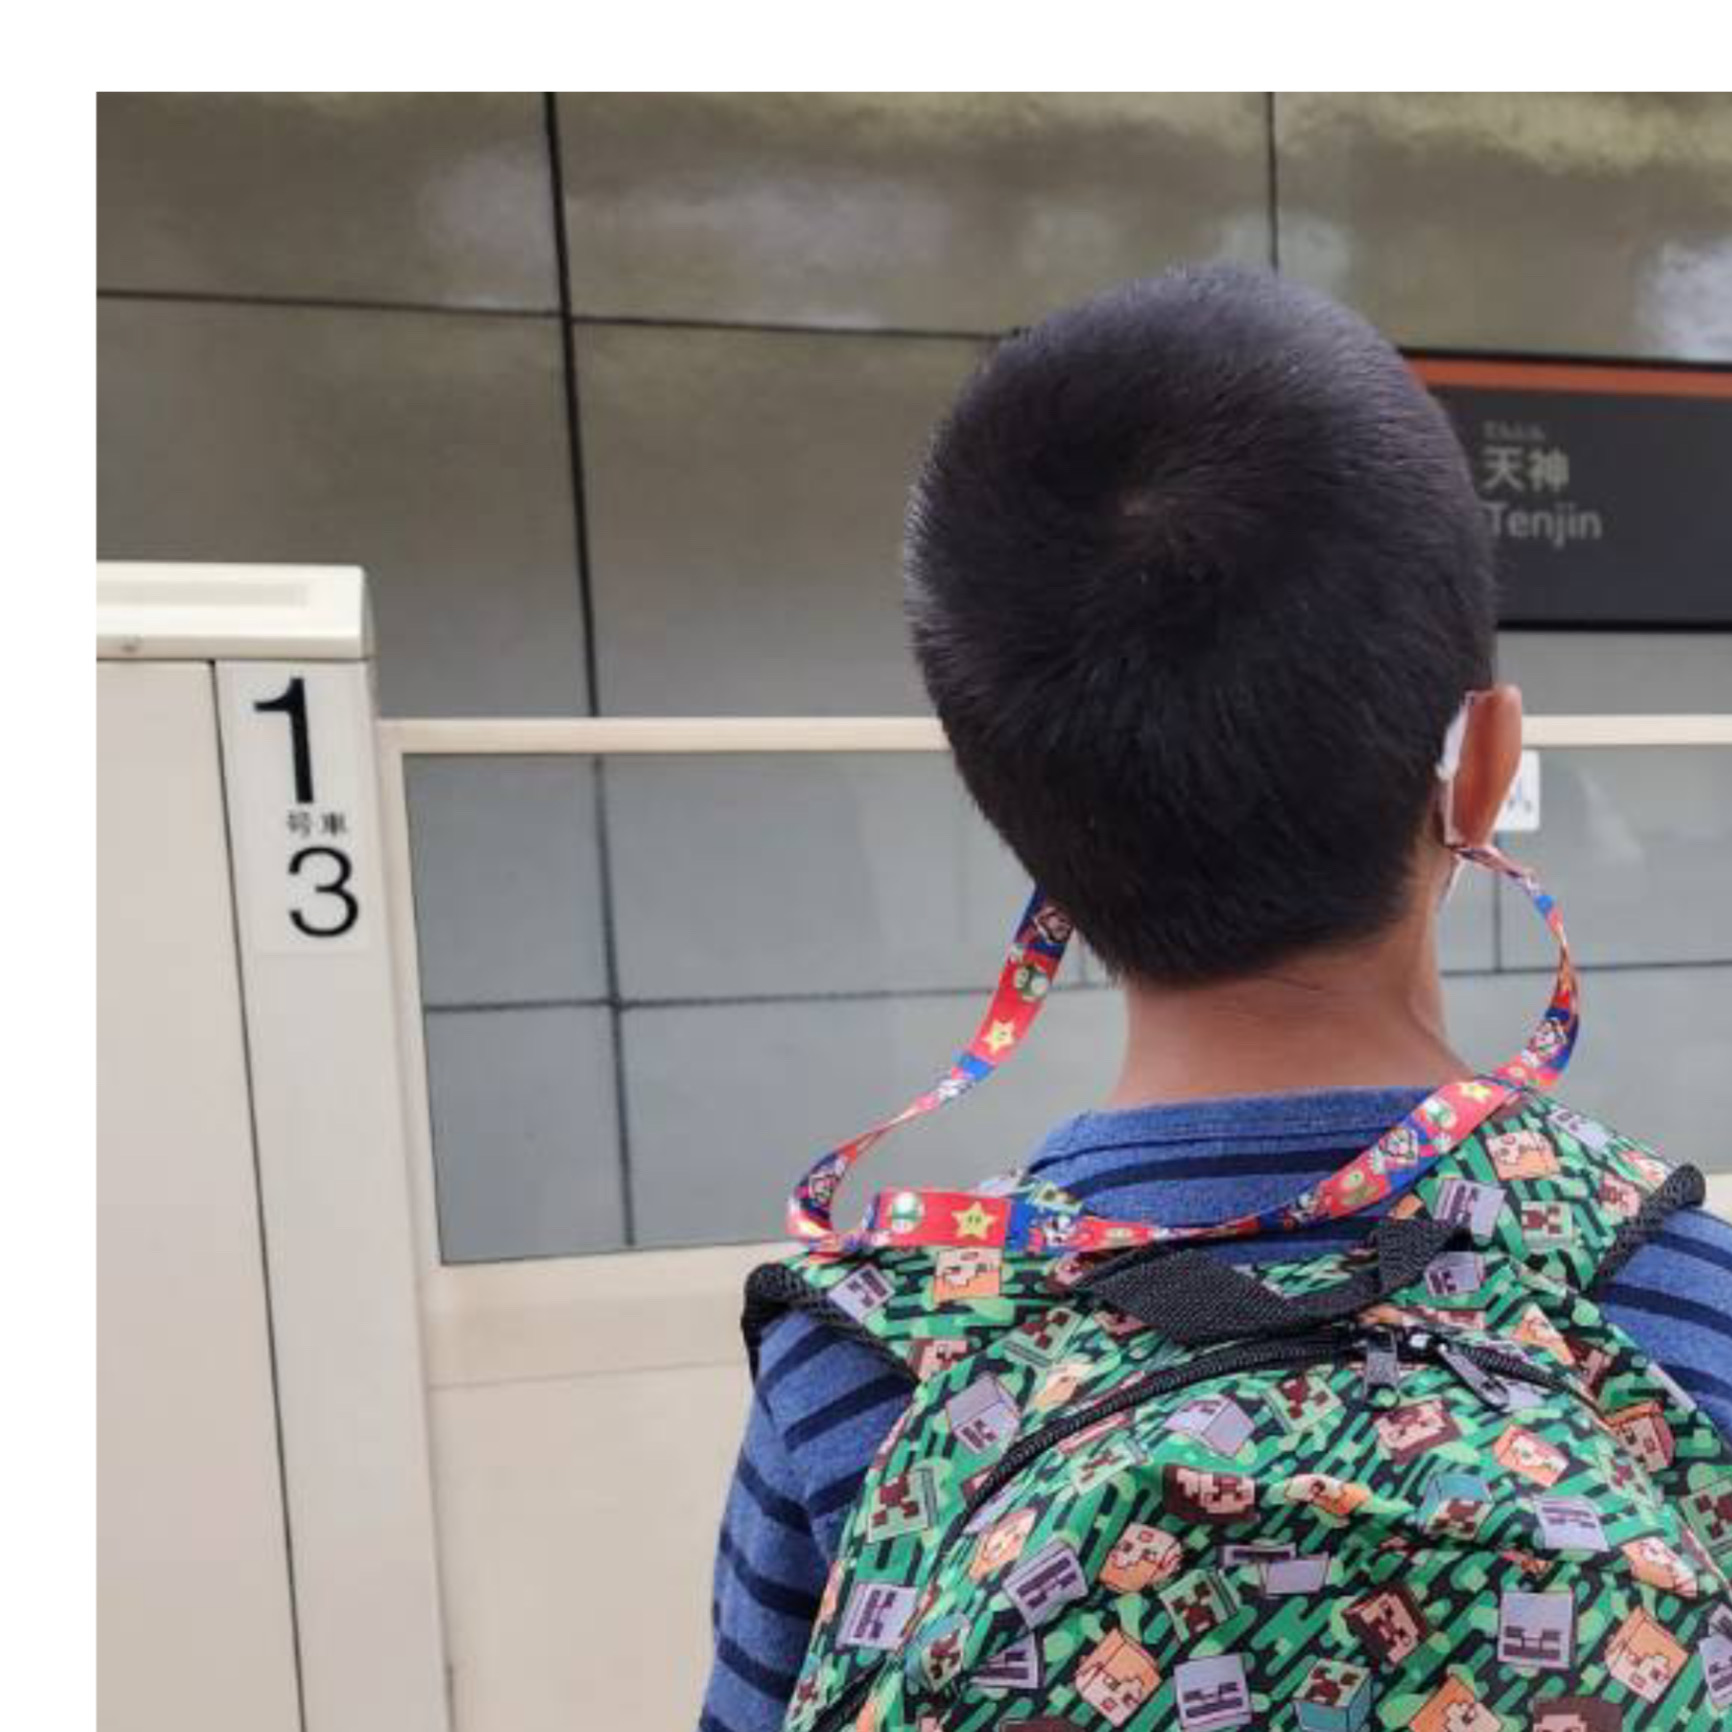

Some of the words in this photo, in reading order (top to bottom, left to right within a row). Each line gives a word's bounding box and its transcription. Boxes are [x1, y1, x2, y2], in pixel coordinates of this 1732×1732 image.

[1484, 446, 1570, 492] 天神
[1483, 502, 1603, 549] Tenjin
[252, 676, 314, 804] 1
[288, 845, 360, 938] 3
